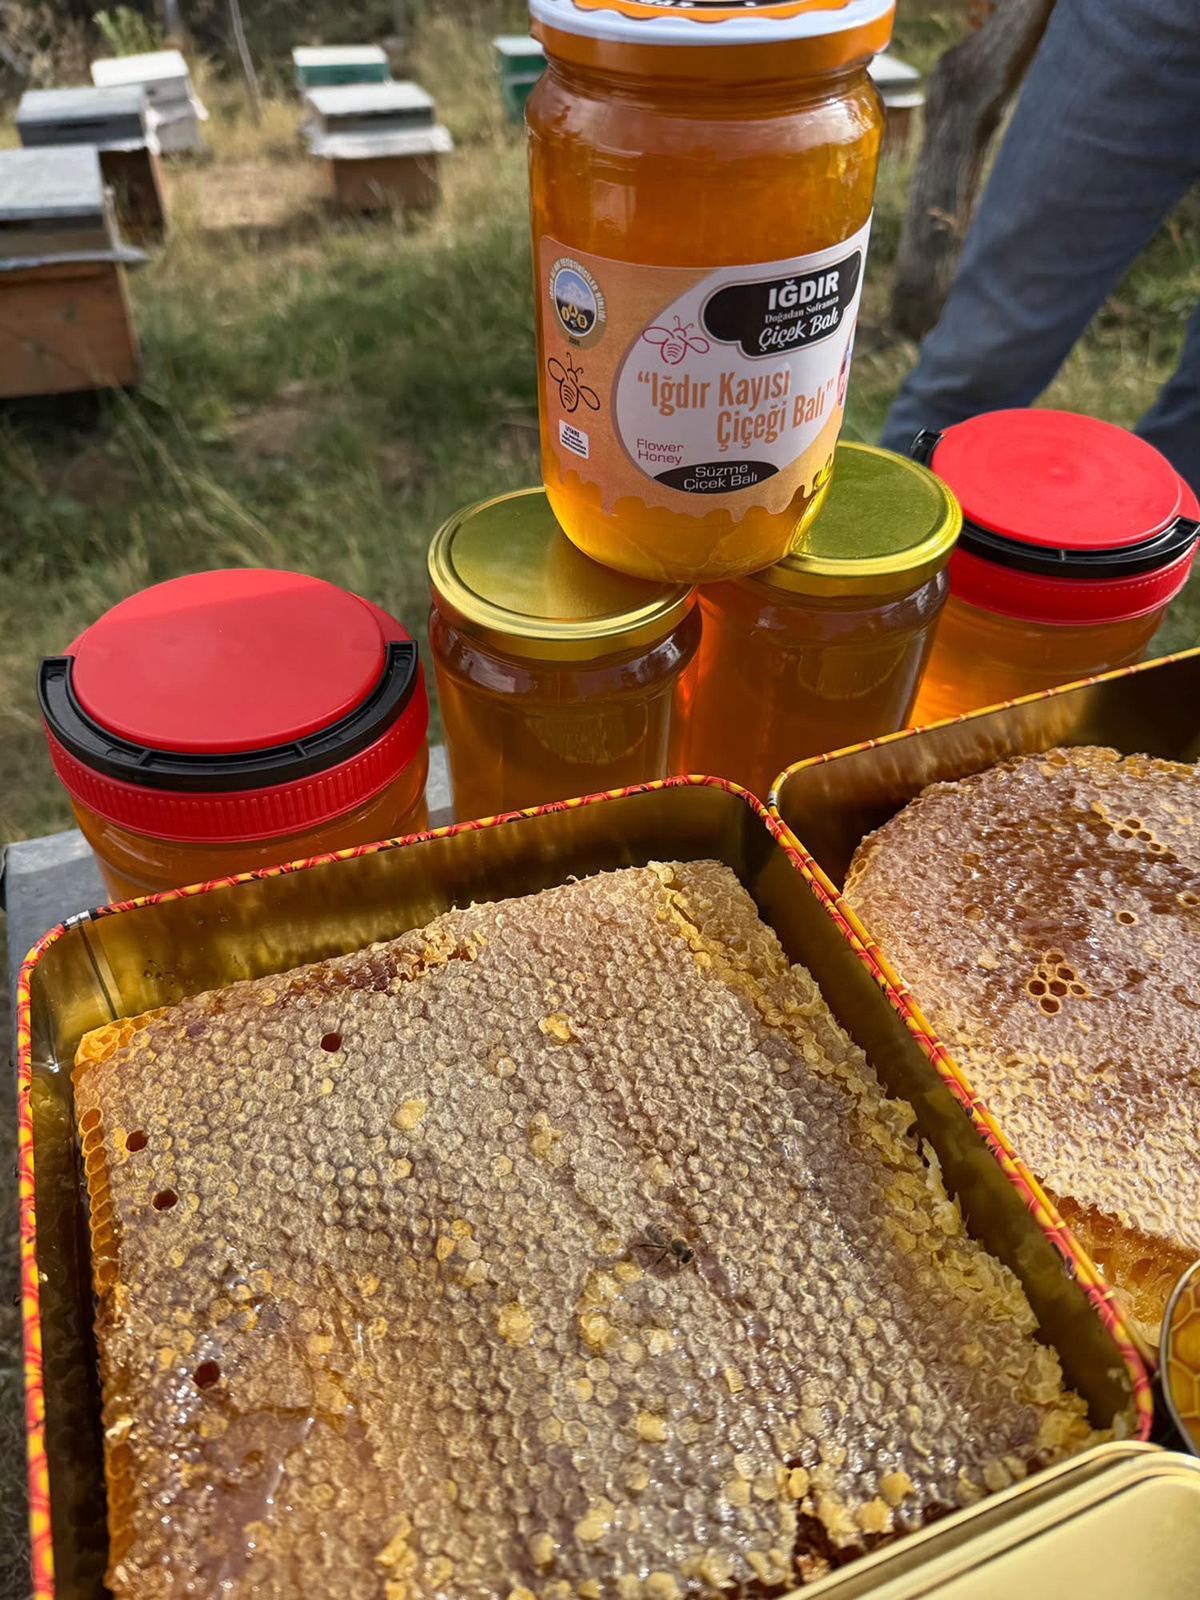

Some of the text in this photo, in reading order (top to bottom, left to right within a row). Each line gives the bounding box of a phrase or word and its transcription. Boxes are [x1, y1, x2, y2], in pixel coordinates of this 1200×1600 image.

[768, 271, 840, 310] IĞDIR
[765, 308, 804, 324] Doğadan
[758, 306, 839, 352] Çiçek Balı
[718, 369, 791, 413] Kayısı
[716, 400, 787, 452] Çiçeği
[636, 438, 684, 453] Flower
[637, 450, 683, 466] Honey
[694, 464, 748, 478] Süzme
[683, 473, 758, 493] Çiçek Balı
